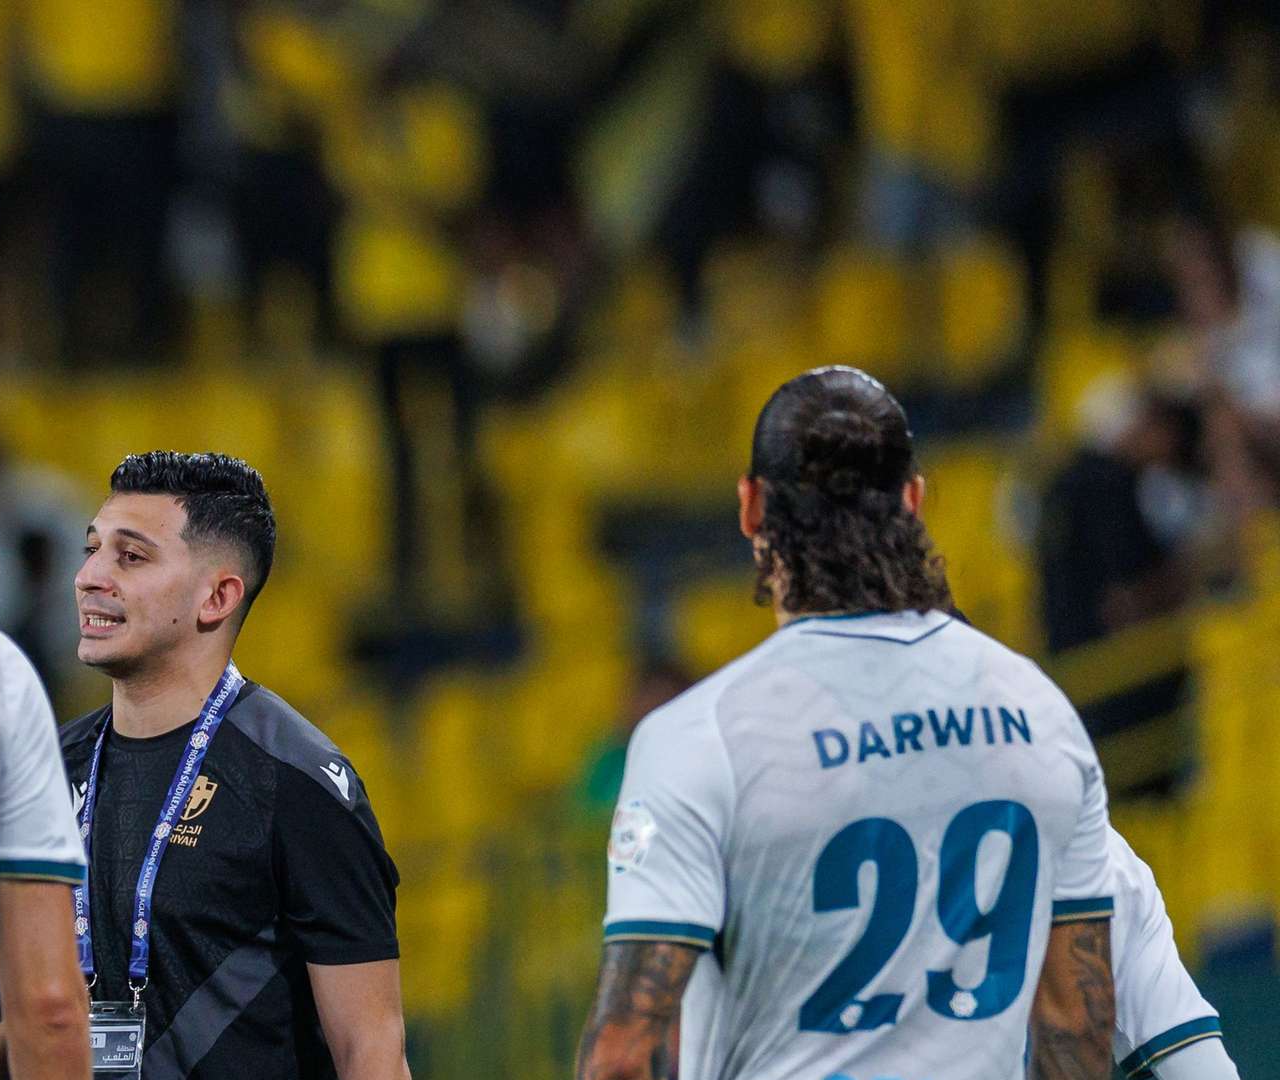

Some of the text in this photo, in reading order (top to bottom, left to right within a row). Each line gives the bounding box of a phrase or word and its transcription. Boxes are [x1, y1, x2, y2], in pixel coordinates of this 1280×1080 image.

[200, 707, 218, 731] LEAGUE
[813, 706, 1032, 769] DARWIN
[164, 749, 199, 822] ROSHN SAUDI LEAGUE
[137, 888, 146, 917] LEAGUE
[798, 799, 1039, 1034] 29
